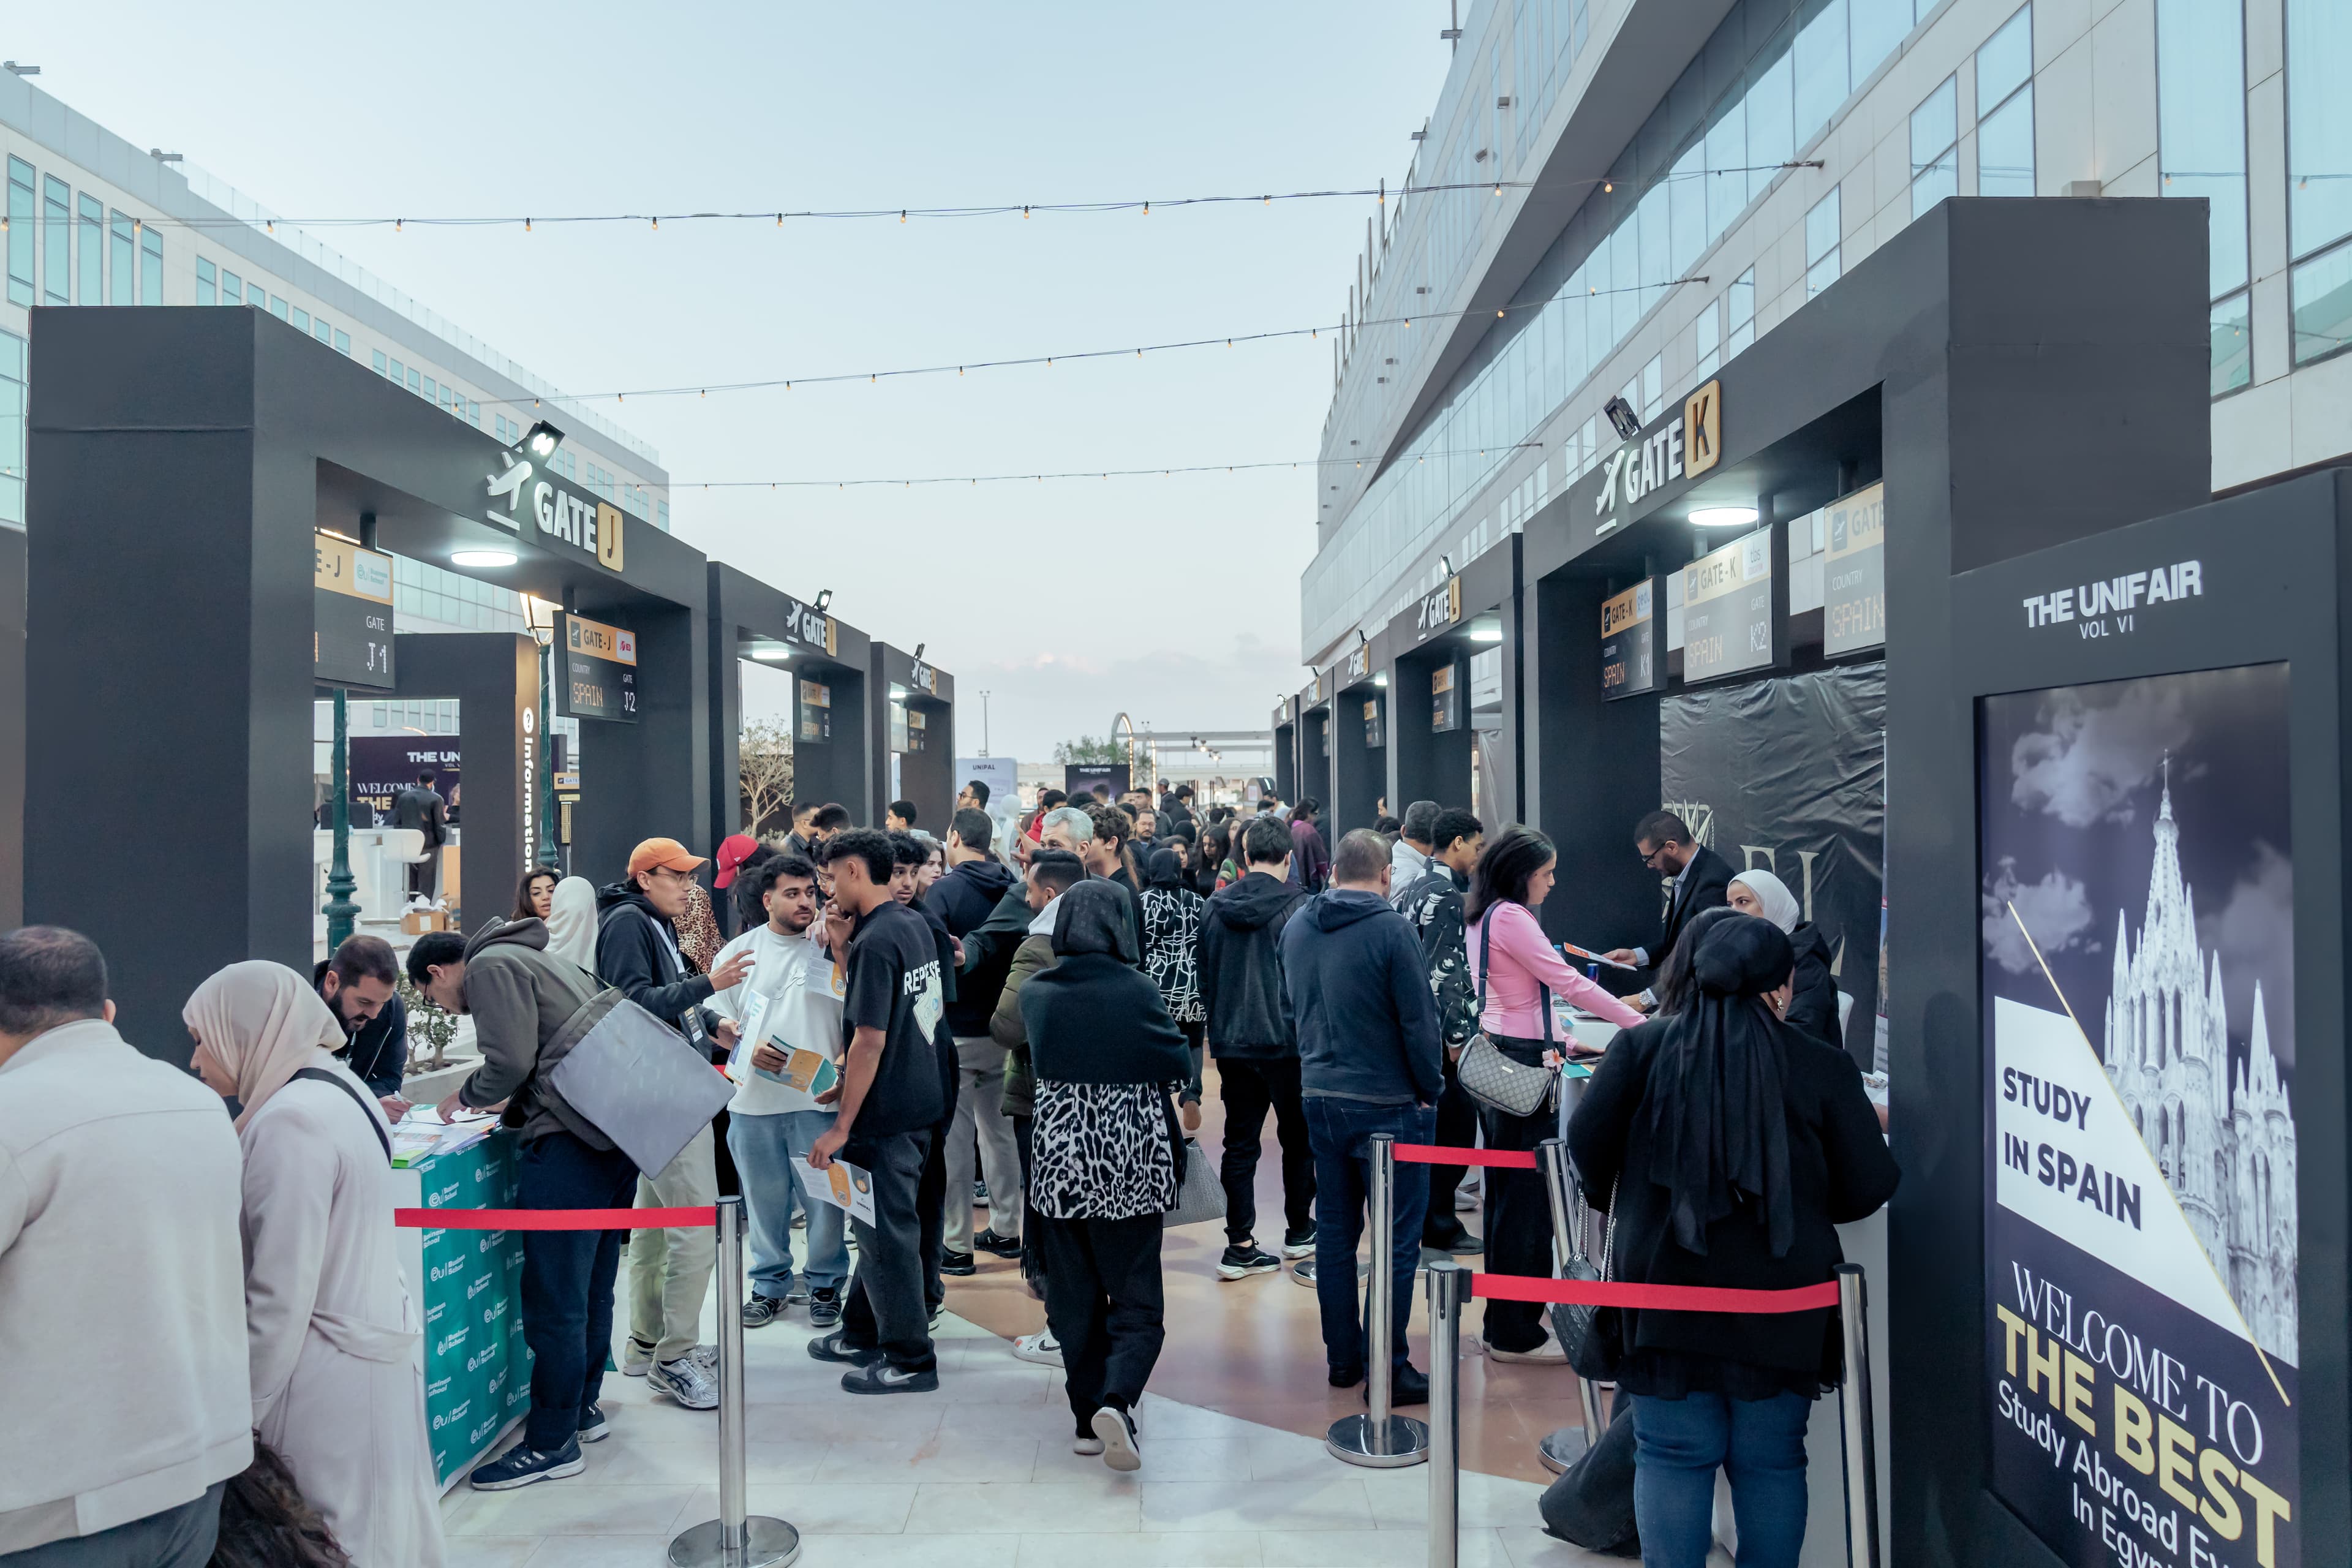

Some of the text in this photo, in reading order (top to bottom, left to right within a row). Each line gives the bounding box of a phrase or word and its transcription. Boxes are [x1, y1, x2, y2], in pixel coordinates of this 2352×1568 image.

[1625, 394, 1710, 504] GATE K
[534, 482, 596, 554] GATE
[334, 555, 341, 578] J
[1701, 562, 1723, 590] GATE
[1832, 569, 1863, 591] COUNTRY
[1751, 595, 1765, 611] GATE
[2023, 559, 2203, 628] THE UNIFAIR
[1429, 588, 1449, 628] GATE
[1612, 603, 1626, 624] GATE
[1629, 598, 1633, 617] K
[1832, 593, 1884, 638] SPAIN
[366, 616, 385, 631] GATE
[802, 613, 826, 649] GATE
[1688, 615, 1709, 631] COUNTRY
[2079, 614, 2134, 639] VOL VI
[584, 629, 602, 649] GATE
[608, 636, 611, 650] J
[1751, 621, 1766, 652] K2
[1604, 645, 1616, 658] COUNTRY
[1689, 635, 1723, 668] SPAIN
[572, 662, 590, 674] COUNTRY
[1604, 662, 1626, 688] SPAIN
[1640, 653, 1649, 678] K1
[623, 674, 633, 684] GATE
[573, 682, 603, 707] SPAIN
[624, 692, 636, 712] J2
[407, 752, 437, 763] THE
[525, 737, 533, 873] Information
[2003, 1066, 2092, 1131] STUDY
[2004, 1131, 2141, 1232] IN SPAIN
[431, 1267, 444, 1281] eu
[448, 1326, 469, 1341] Business
[448, 1334, 466, 1349] School
[2011, 1261, 2263, 1466] WELCOME TO
[451, 1407, 467, 1422] School
[1997, 1303, 2291, 1568] THE BEST
[1999, 1379, 2066, 1468] Study
[2073, 1439, 2178, 1556] Abroad
[2073, 1482, 2173, 1568] In Egy
